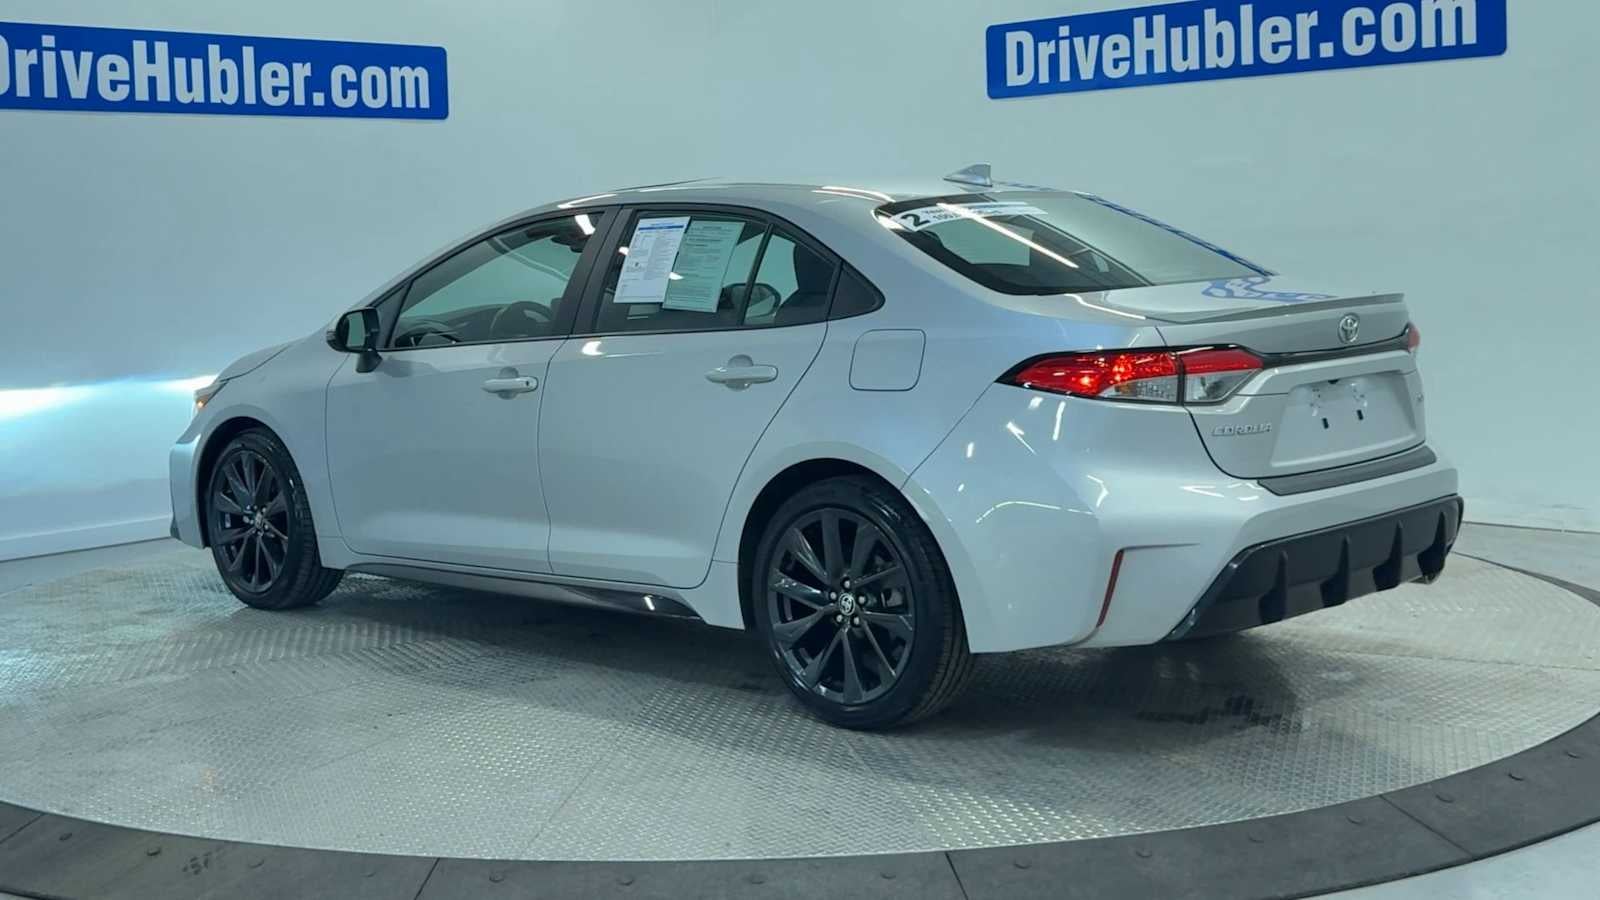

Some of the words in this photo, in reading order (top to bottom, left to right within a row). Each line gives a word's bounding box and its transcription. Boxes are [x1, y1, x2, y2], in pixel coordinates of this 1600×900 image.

[1005, 0, 1477, 87] DriveHubler.com
[901, 213, 930, 227] 2
[1211, 423, 1272, 436] COROLLA
